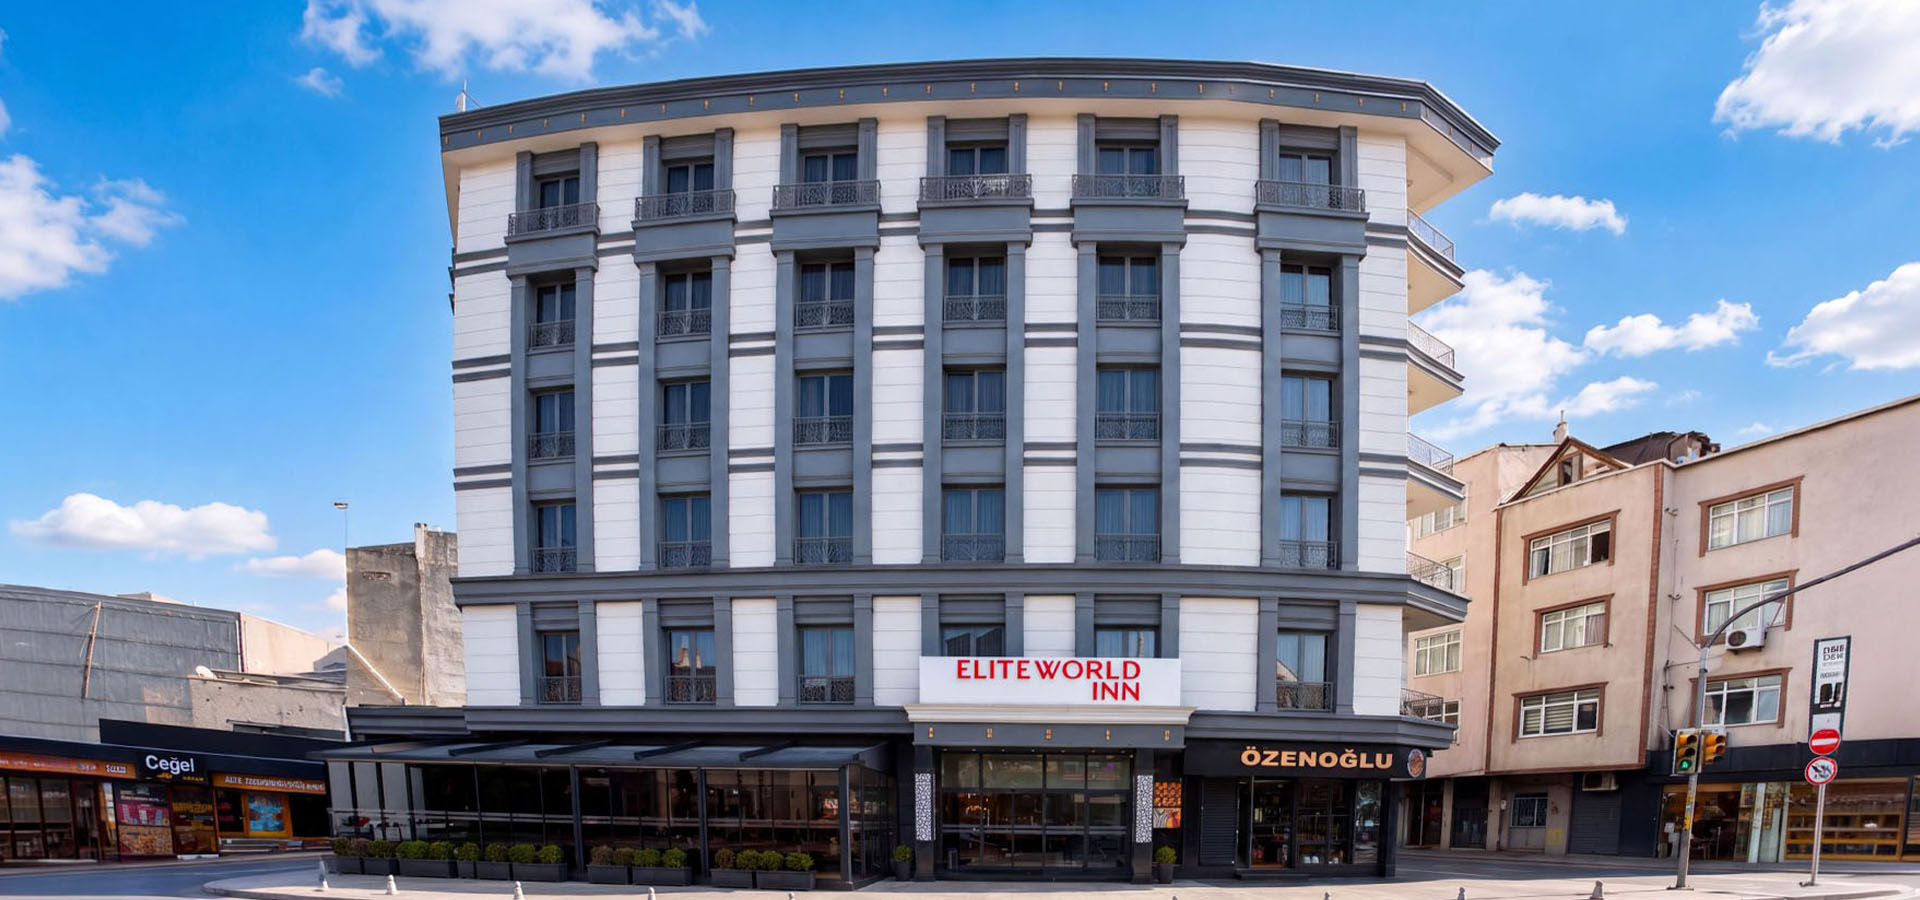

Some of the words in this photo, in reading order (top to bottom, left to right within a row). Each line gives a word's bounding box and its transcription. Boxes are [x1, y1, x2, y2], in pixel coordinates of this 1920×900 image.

[1092, 681, 1140, 701] INN
[145, 754, 195, 775] Ceğel
[1240, 745, 1393, 769] ÖZENOĞLU
